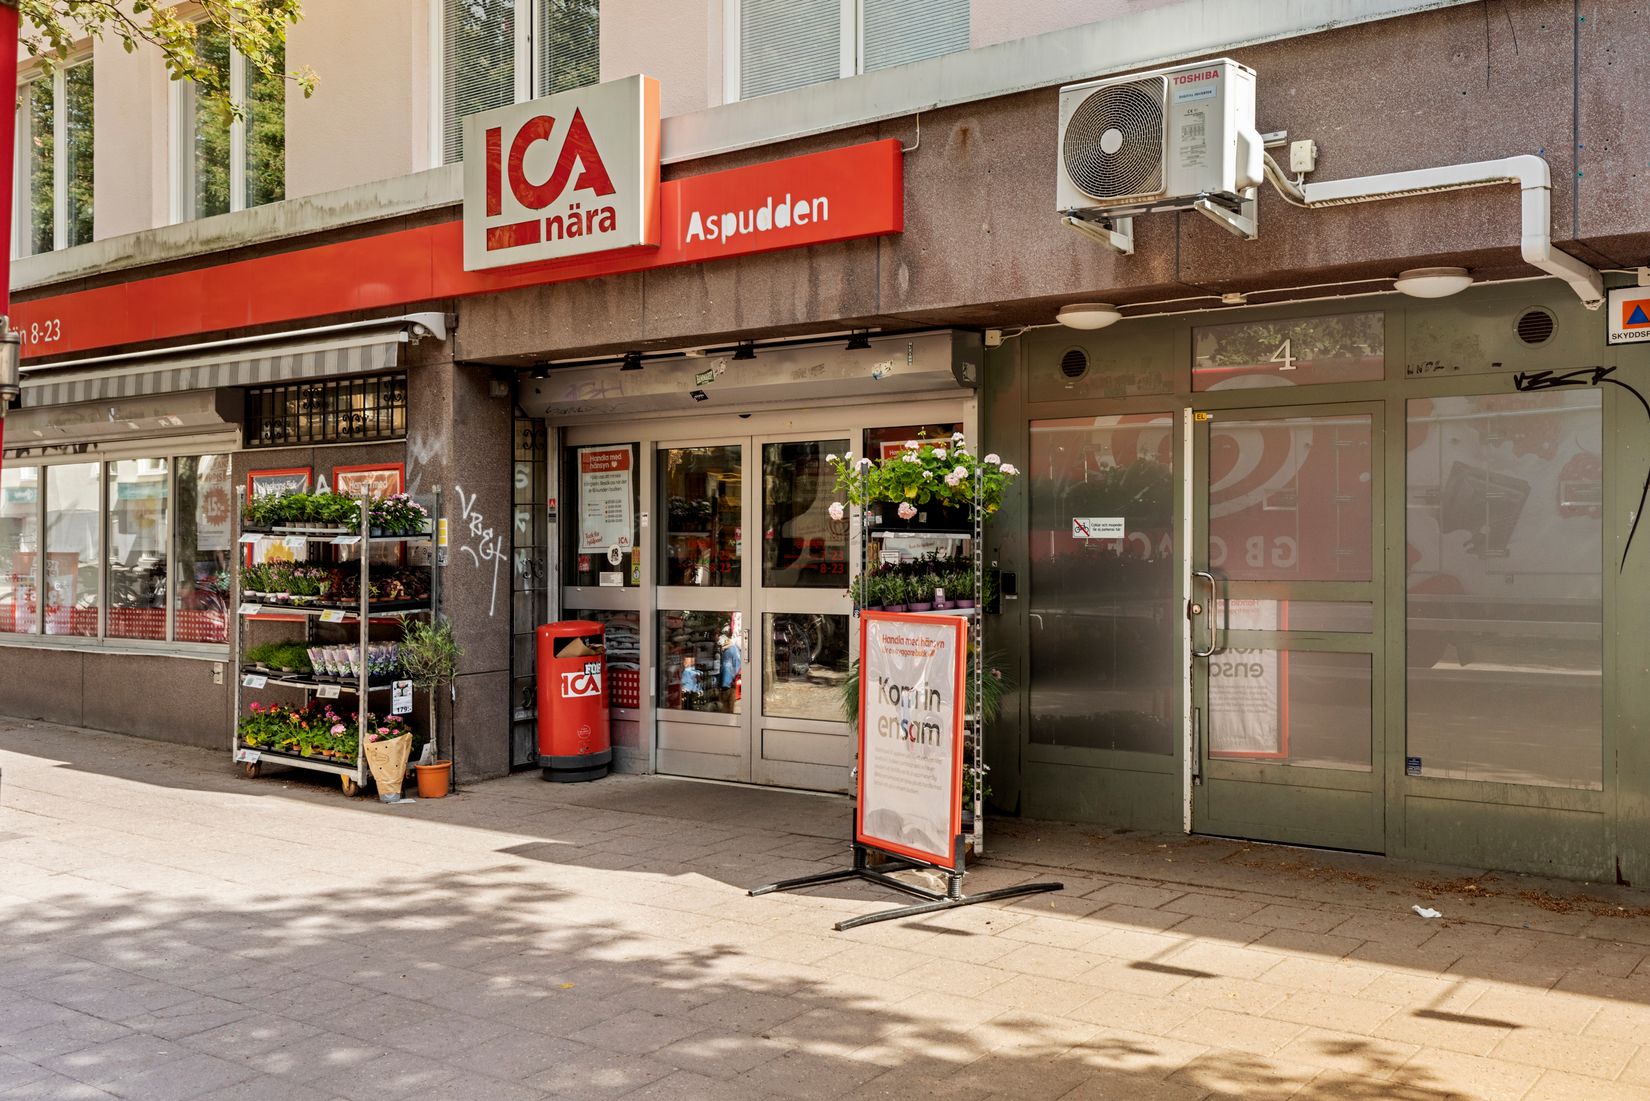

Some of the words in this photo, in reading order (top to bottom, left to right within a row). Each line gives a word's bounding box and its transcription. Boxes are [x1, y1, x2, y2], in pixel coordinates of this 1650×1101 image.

[1173, 70, 1219, 85] TOSHIBA
[486, 106, 616, 210] ICA
[545, 203, 616, 242] nära
[685, 193, 829, 244] Aspudden
[31, 319, 61, 344] 8-23
[1270, 339, 1297, 371] 4
[882, 634, 904, 646] Handla
[563, 674, 600, 696] ICA
[878, 676, 918, 709] Kom
[924, 681, 941, 712] in
[878, 715, 940, 746] ensam
